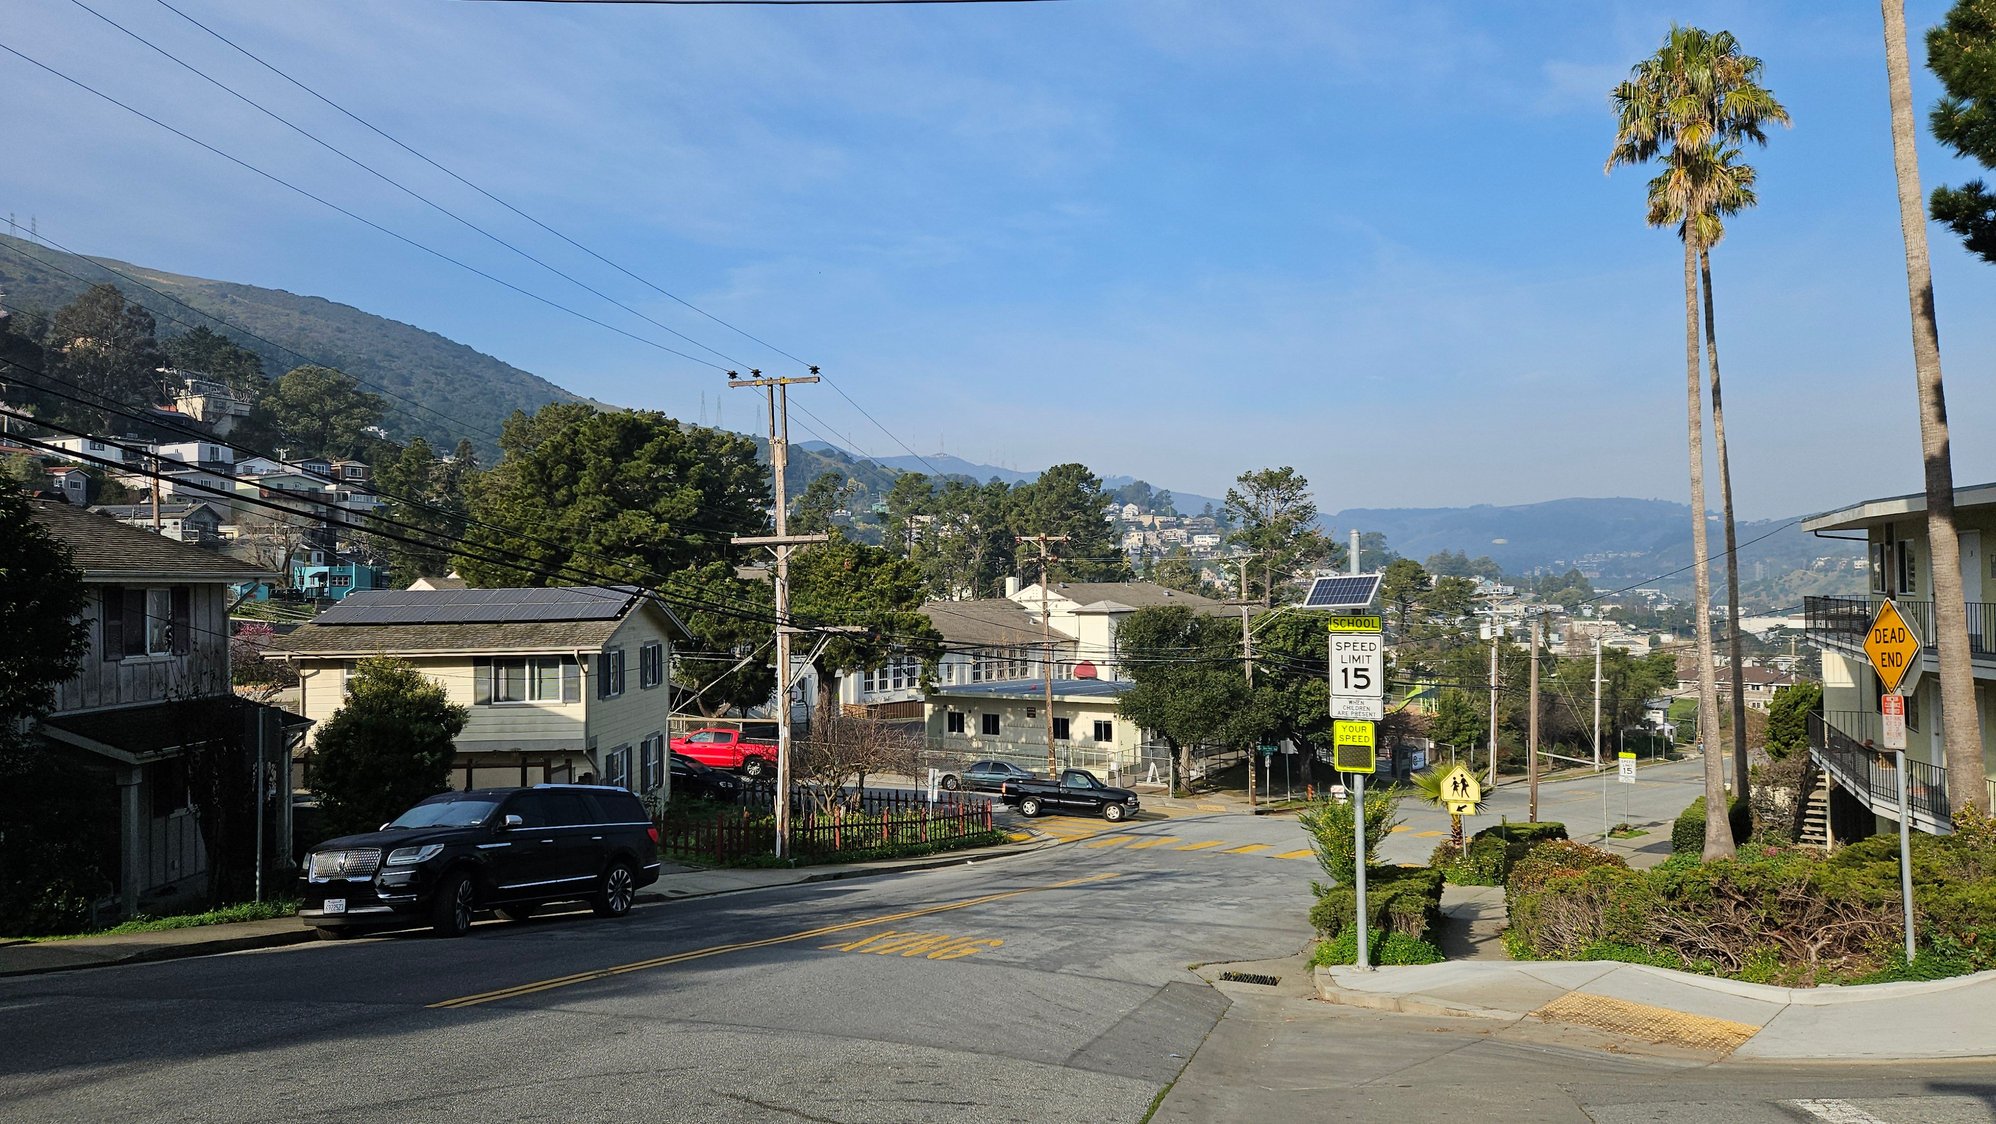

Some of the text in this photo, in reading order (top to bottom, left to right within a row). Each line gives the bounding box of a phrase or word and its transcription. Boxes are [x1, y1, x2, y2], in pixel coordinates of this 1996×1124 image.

[1332, 618, 1378, 629] SCHOOL
[1874, 627, 1906, 644] DEAD
[1335, 641, 1377, 652] SPEED
[1340, 654, 1372, 664] LIMIT
[1880, 651, 1903, 668] END
[1341, 667, 1371, 690] 15
[1341, 725, 1367, 733] YOUR
[1338, 734, 1370, 743] SPEED
[1622, 767, 1633, 775] 15
